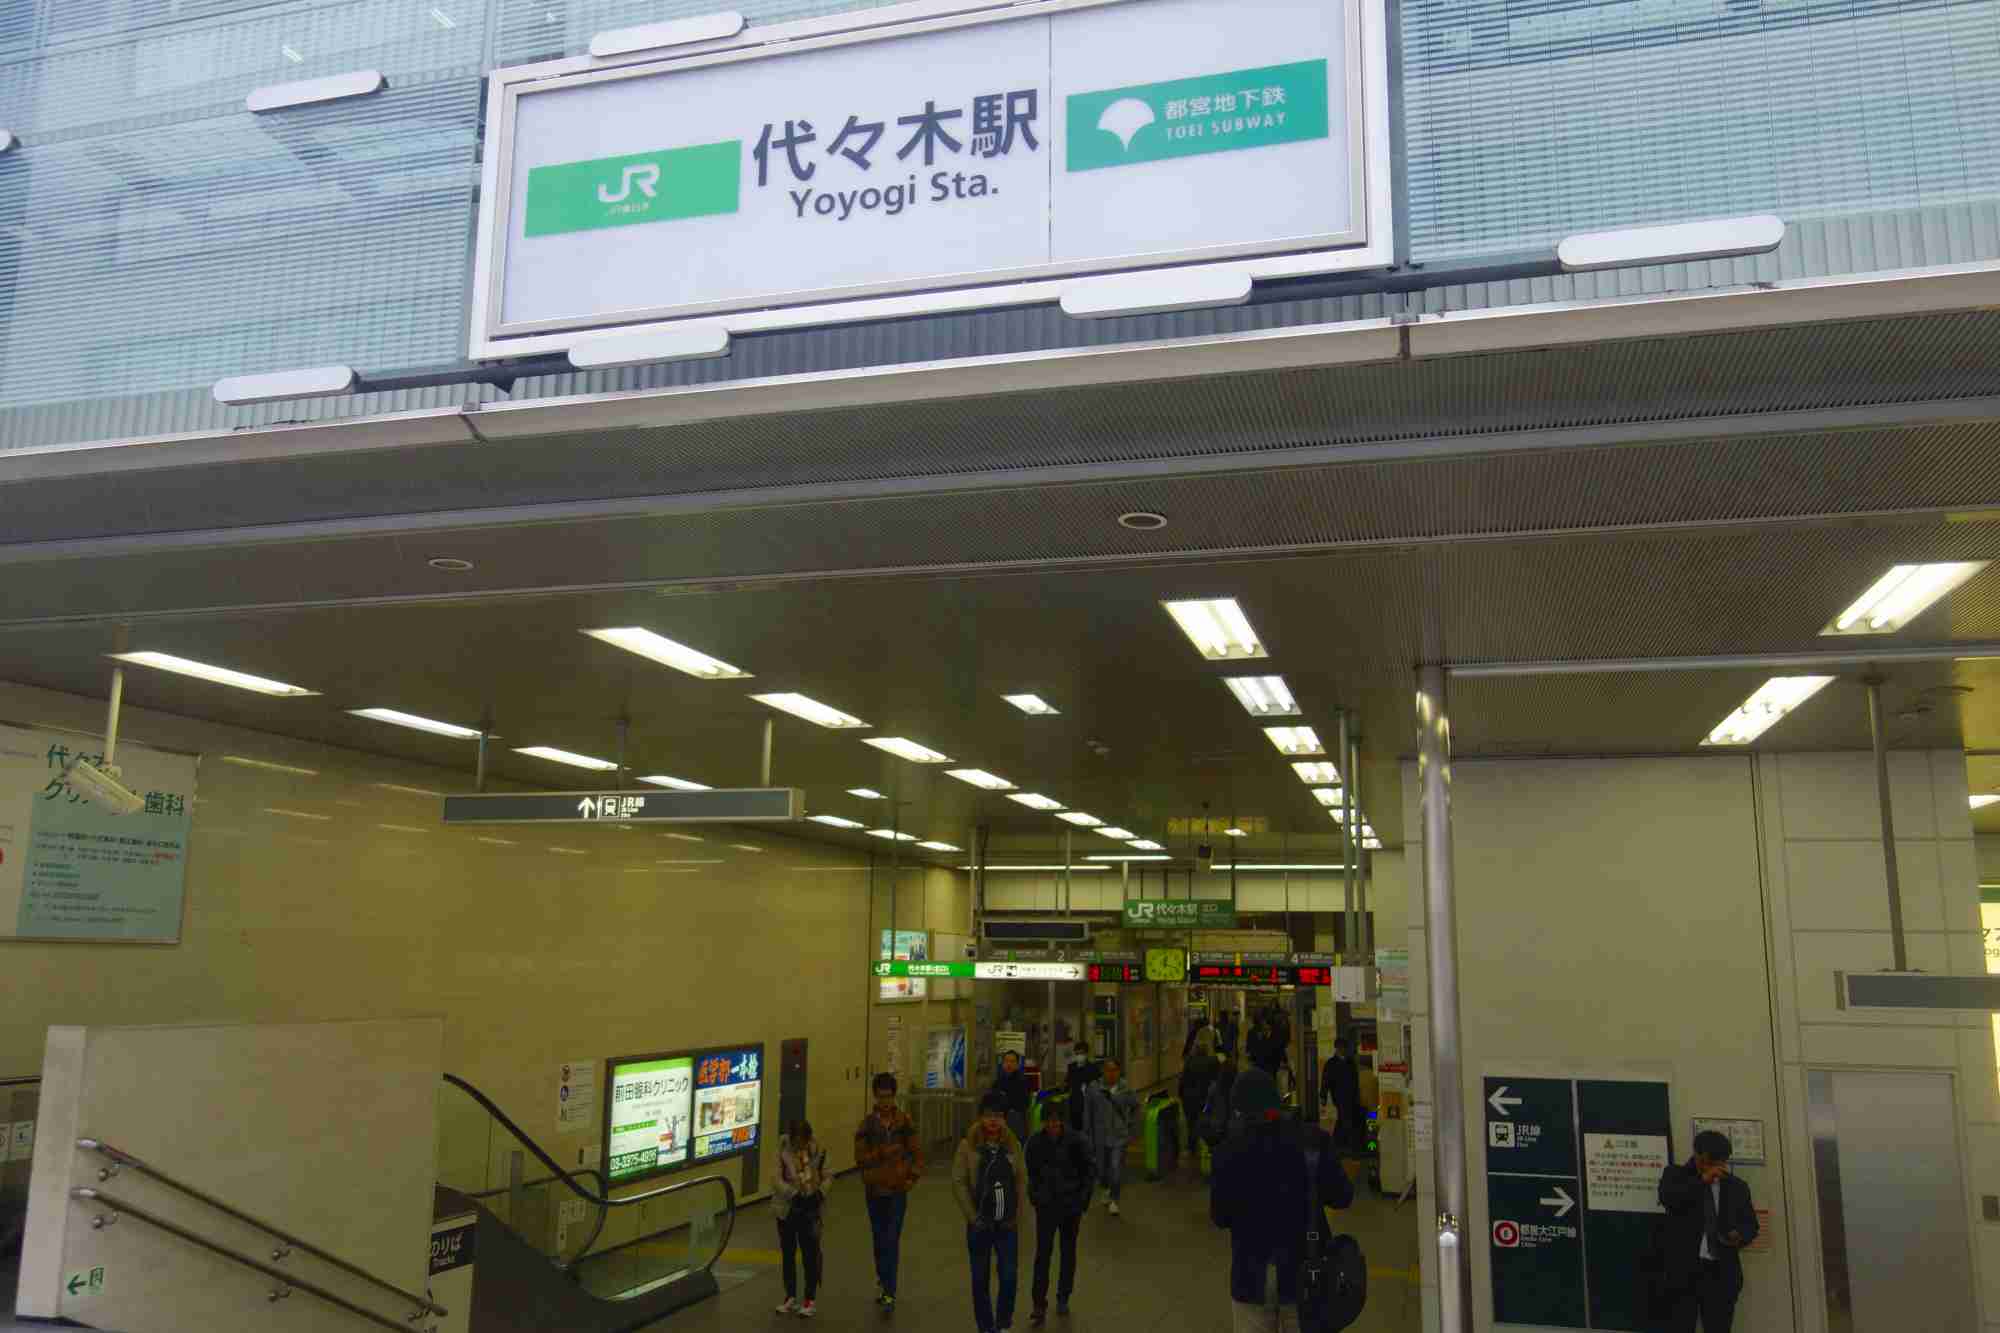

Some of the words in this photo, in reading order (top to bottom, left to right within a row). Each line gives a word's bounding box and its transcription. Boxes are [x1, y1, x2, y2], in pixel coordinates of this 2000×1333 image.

[1164, 84, 1287, 121] 都営地下鉄
[752, 88, 1039, 188] 代々木駅
[1166, 127, 1204, 141] TOEI
[1211, 112, 1287, 136] SUBWAY
[597, 163, 660, 203] JR
[788, 174, 917, 221] Yoyogi
[930, 170, 999, 202] Sta.
[1127, 903, 1155, 919] JR
[875, 964, 891, 975] JR
